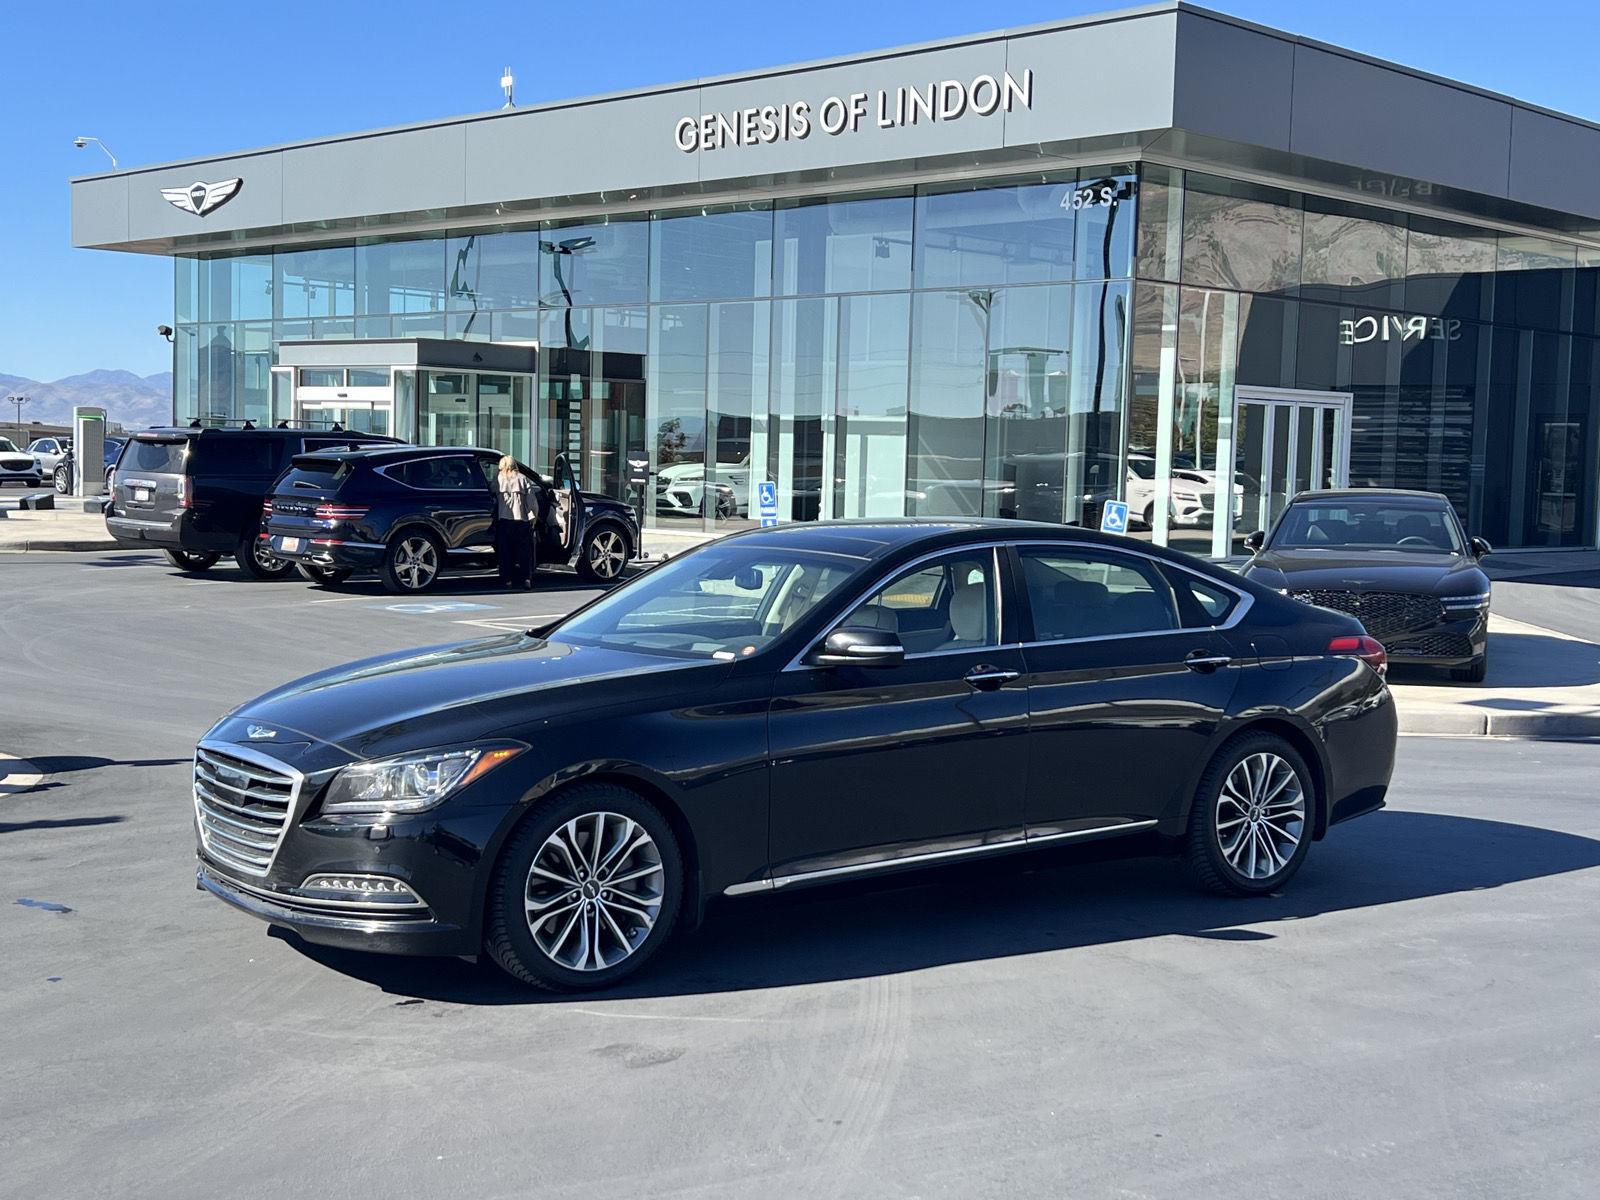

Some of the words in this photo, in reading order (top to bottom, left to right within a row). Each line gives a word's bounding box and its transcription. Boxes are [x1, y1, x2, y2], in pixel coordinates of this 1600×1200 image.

[674, 100, 811, 153] GENESIS
[819, 92, 868, 136] OF
[877, 68, 1034, 129] LINDON
[1060, 189, 1093, 211] 452
[1099, 186, 1118, 208] S.
